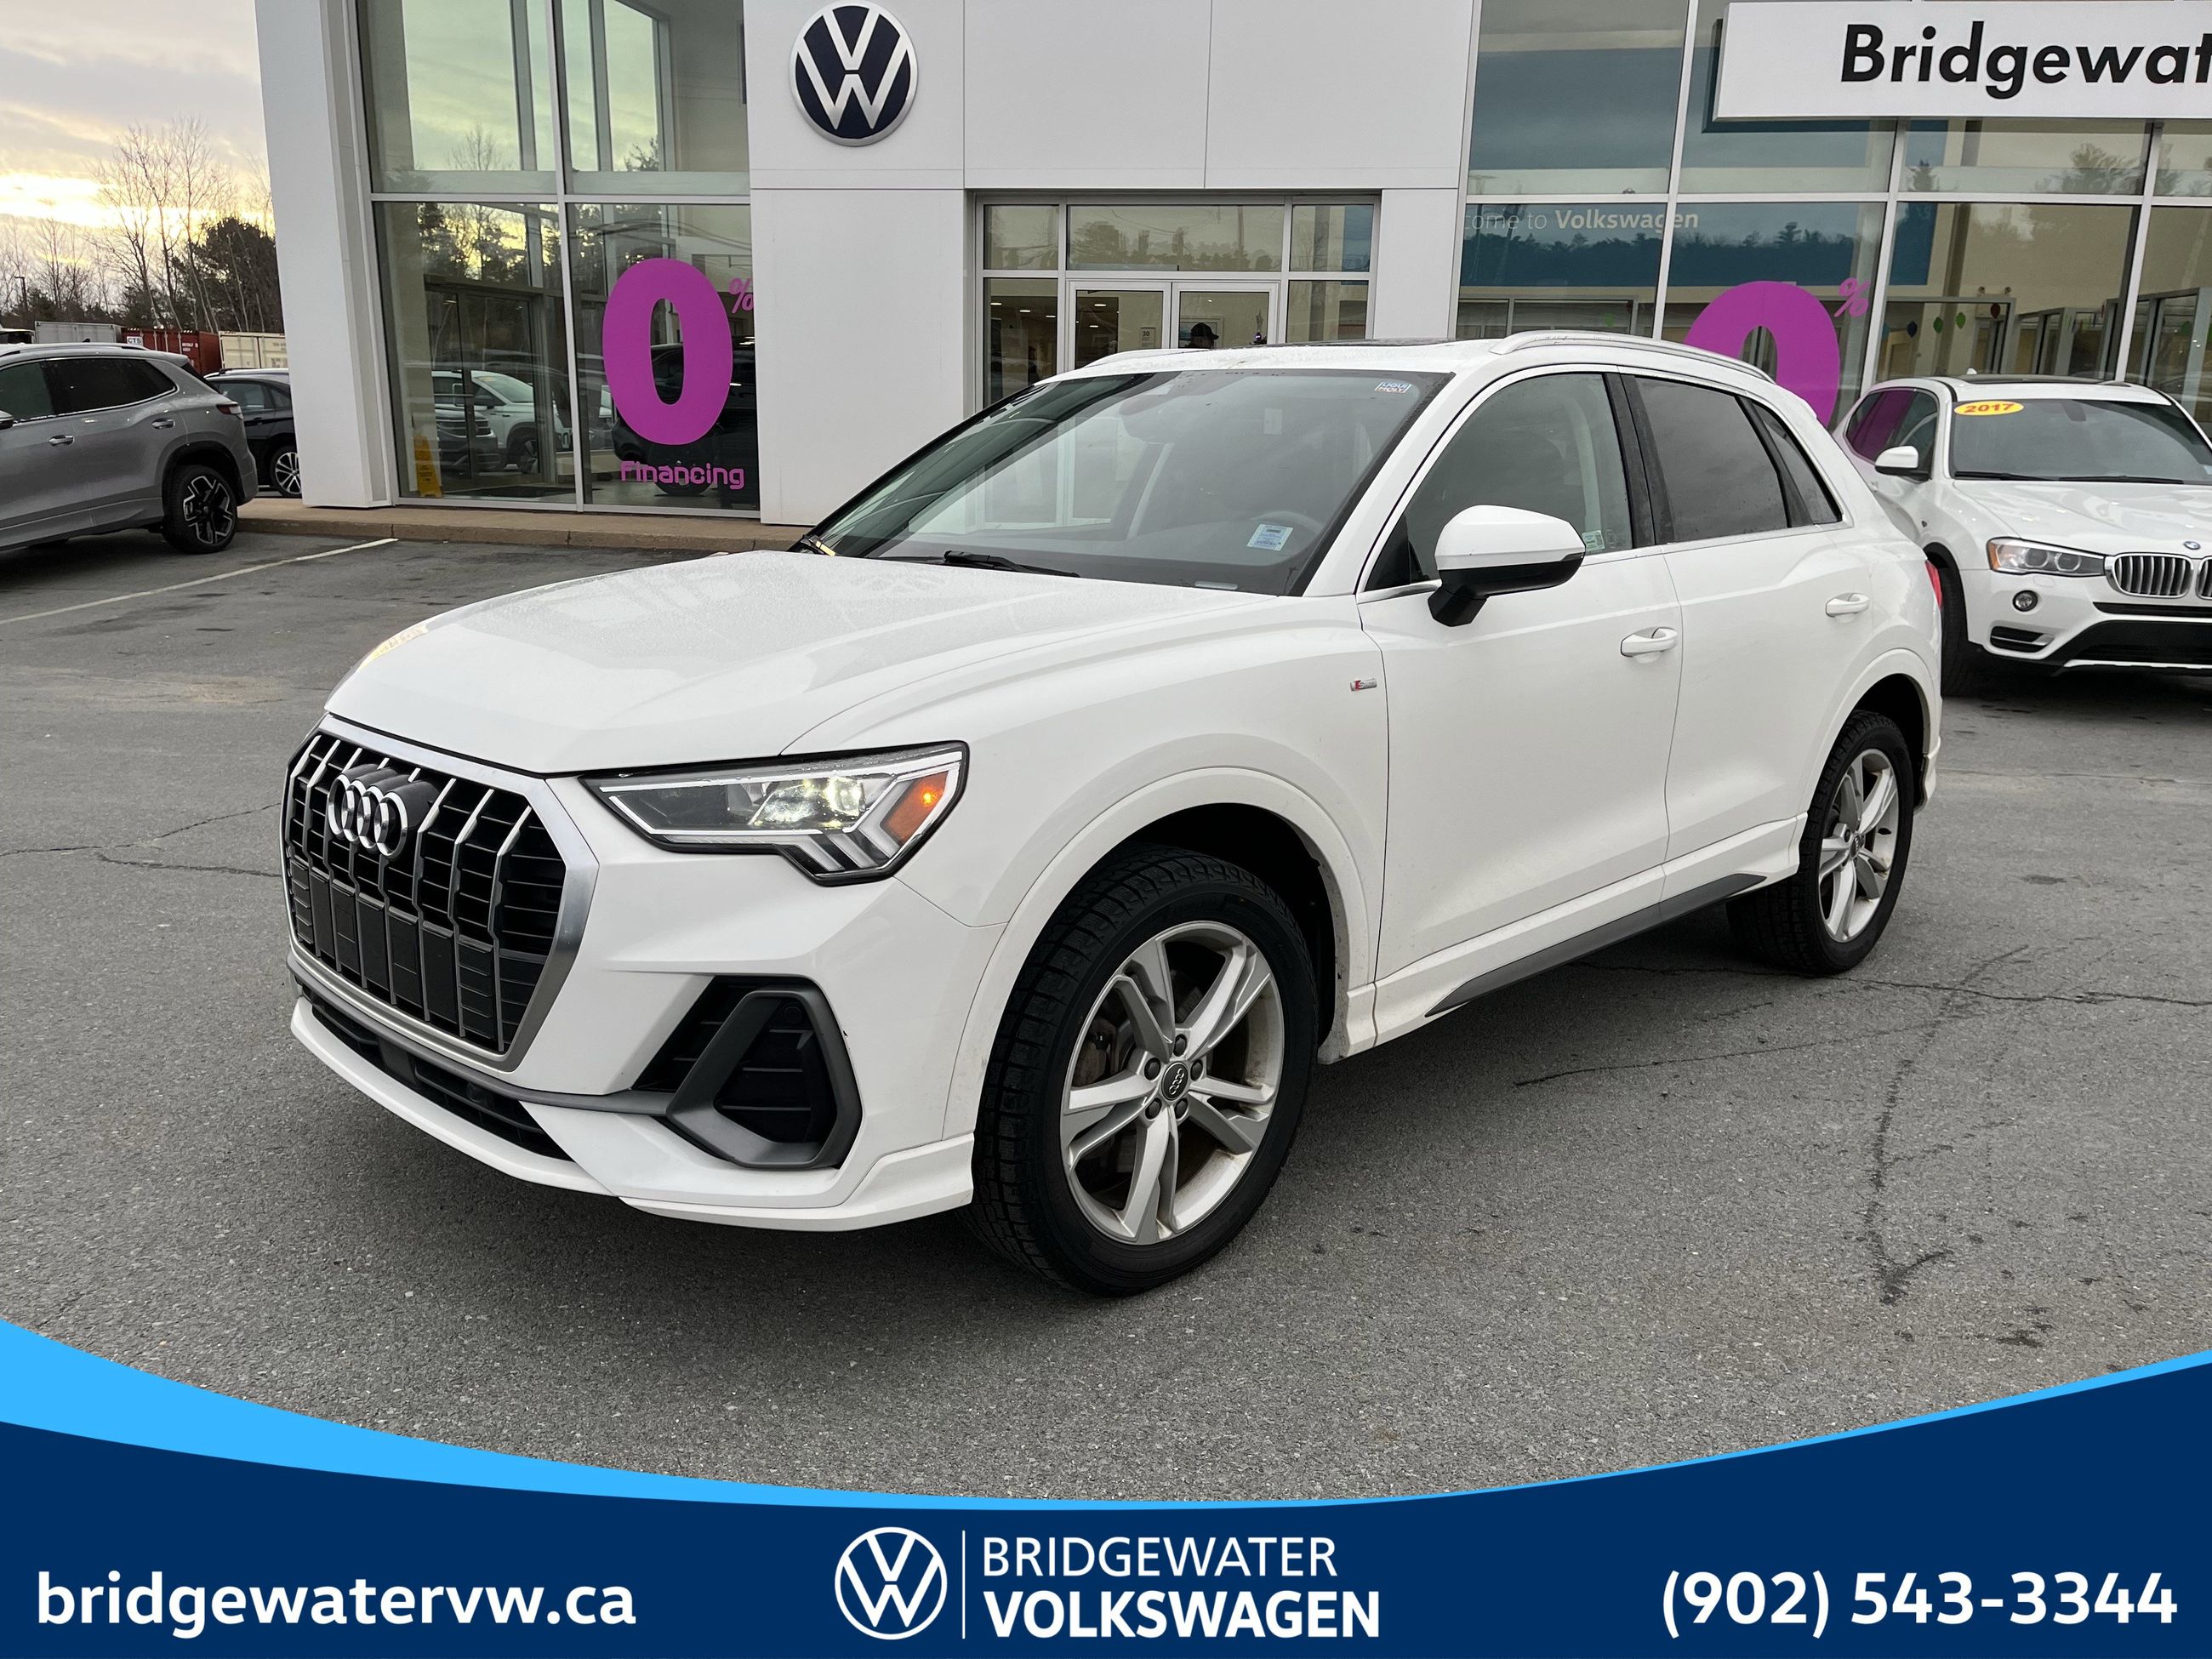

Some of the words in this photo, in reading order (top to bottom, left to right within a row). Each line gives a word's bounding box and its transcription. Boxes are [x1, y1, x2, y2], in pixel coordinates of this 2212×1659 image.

[1841, 20, 2212, 100] Bridgewat
[1527, 213, 1548, 230] to
[1964, 403, 2015, 413] 2017
[620, 460, 745, 490] Financing
